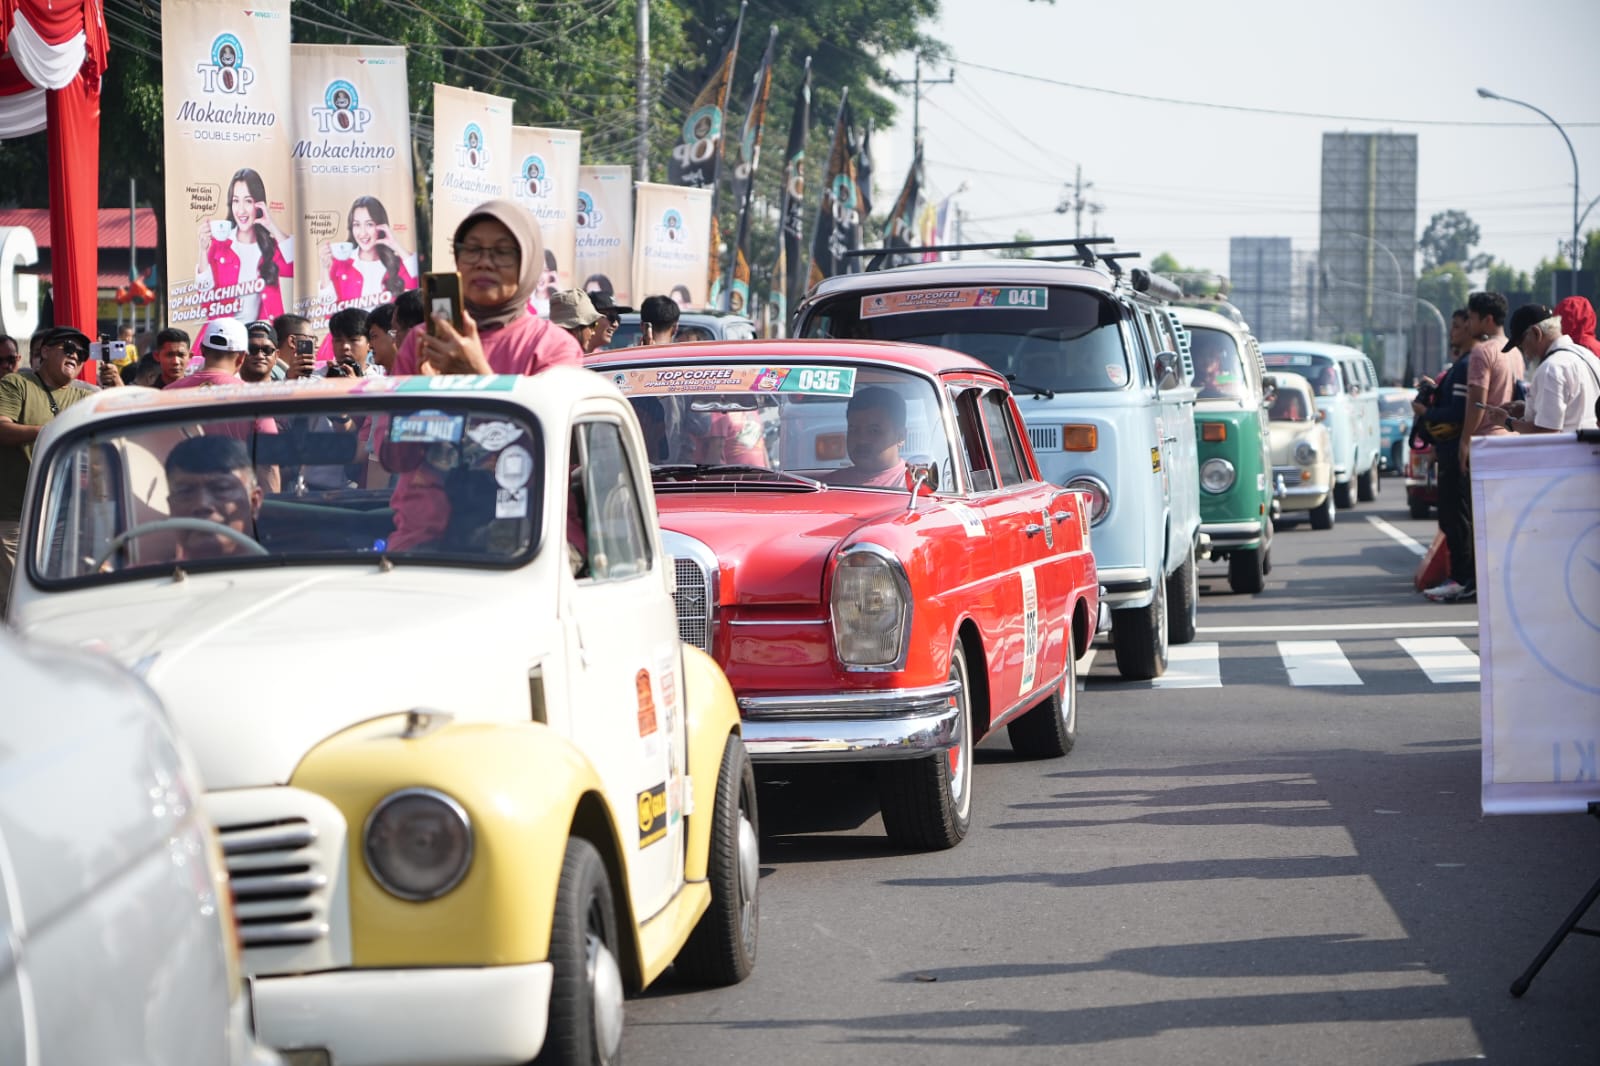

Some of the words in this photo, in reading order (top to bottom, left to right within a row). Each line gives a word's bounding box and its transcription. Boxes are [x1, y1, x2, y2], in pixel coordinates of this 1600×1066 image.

[198, 64, 254, 95] TOP
[176, 100, 275, 127] Mokachinno
[312, 107, 371, 133] TOP
[194, 130, 231, 142] DOUBLE
[292, 139, 395, 159] Mokachinno
[455, 144, 490, 171] TOP
[312, 165, 349, 174] DOUBLE
[441, 172, 502, 196] Mokachinno
[512, 176, 553, 198] TOP
[190, 202, 216, 212] Single?
[576, 210, 603, 229] OP
[183, 278, 265, 306] MOKACHINNO
[1008, 289, 1038, 305] 041
[172, 307, 208, 323] Double
[208, 298, 244, 317] Shot!
[656, 371, 683, 381] TOP
[683, 369, 734, 379] COFFEE
[798, 370, 840, 390] 035
